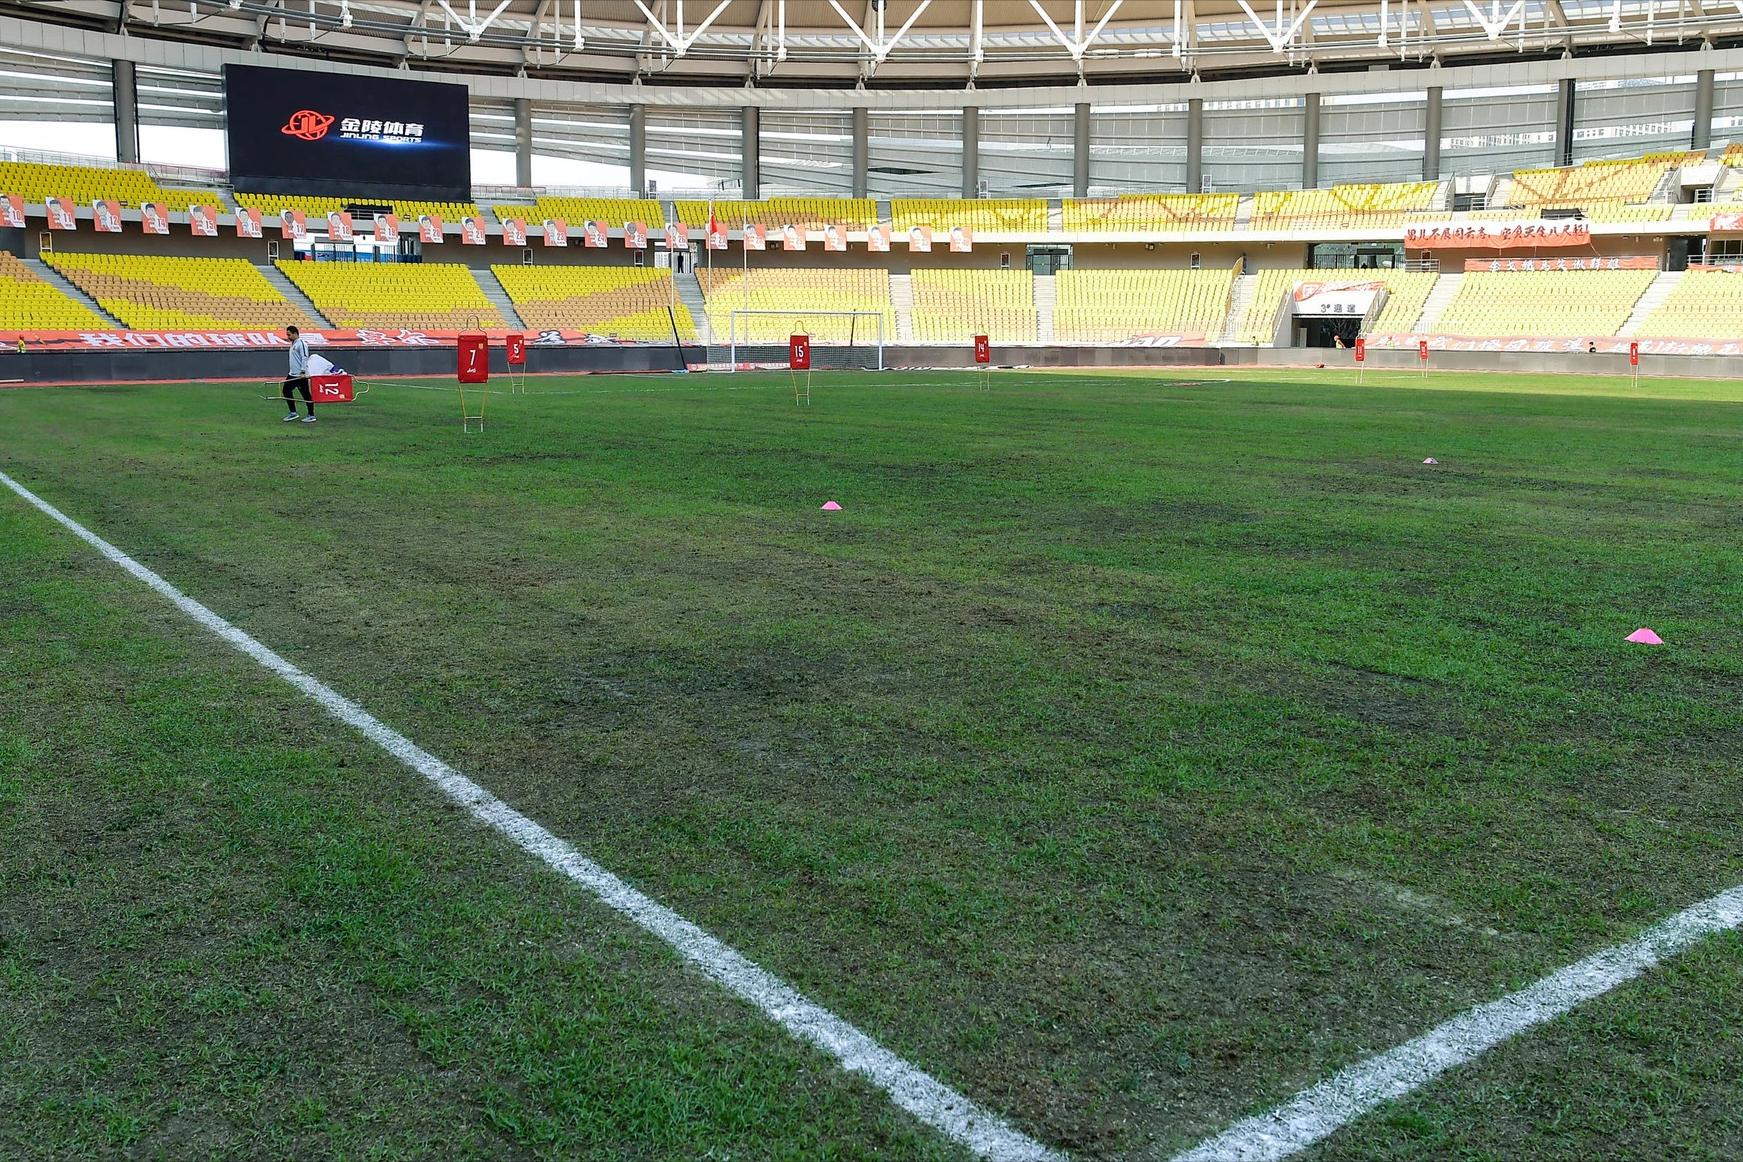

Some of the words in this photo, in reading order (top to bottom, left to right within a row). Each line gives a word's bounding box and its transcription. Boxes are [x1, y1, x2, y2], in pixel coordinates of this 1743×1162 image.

[340, 118, 424, 136] 金陵体育
[340, 132, 380, 140] JINLING
[382, 135, 422, 143] SPORTS
[513, 343, 519, 354] 5
[794, 345, 804, 358] 15
[469, 349, 477, 366] 7
[324, 382, 339, 395] 12
